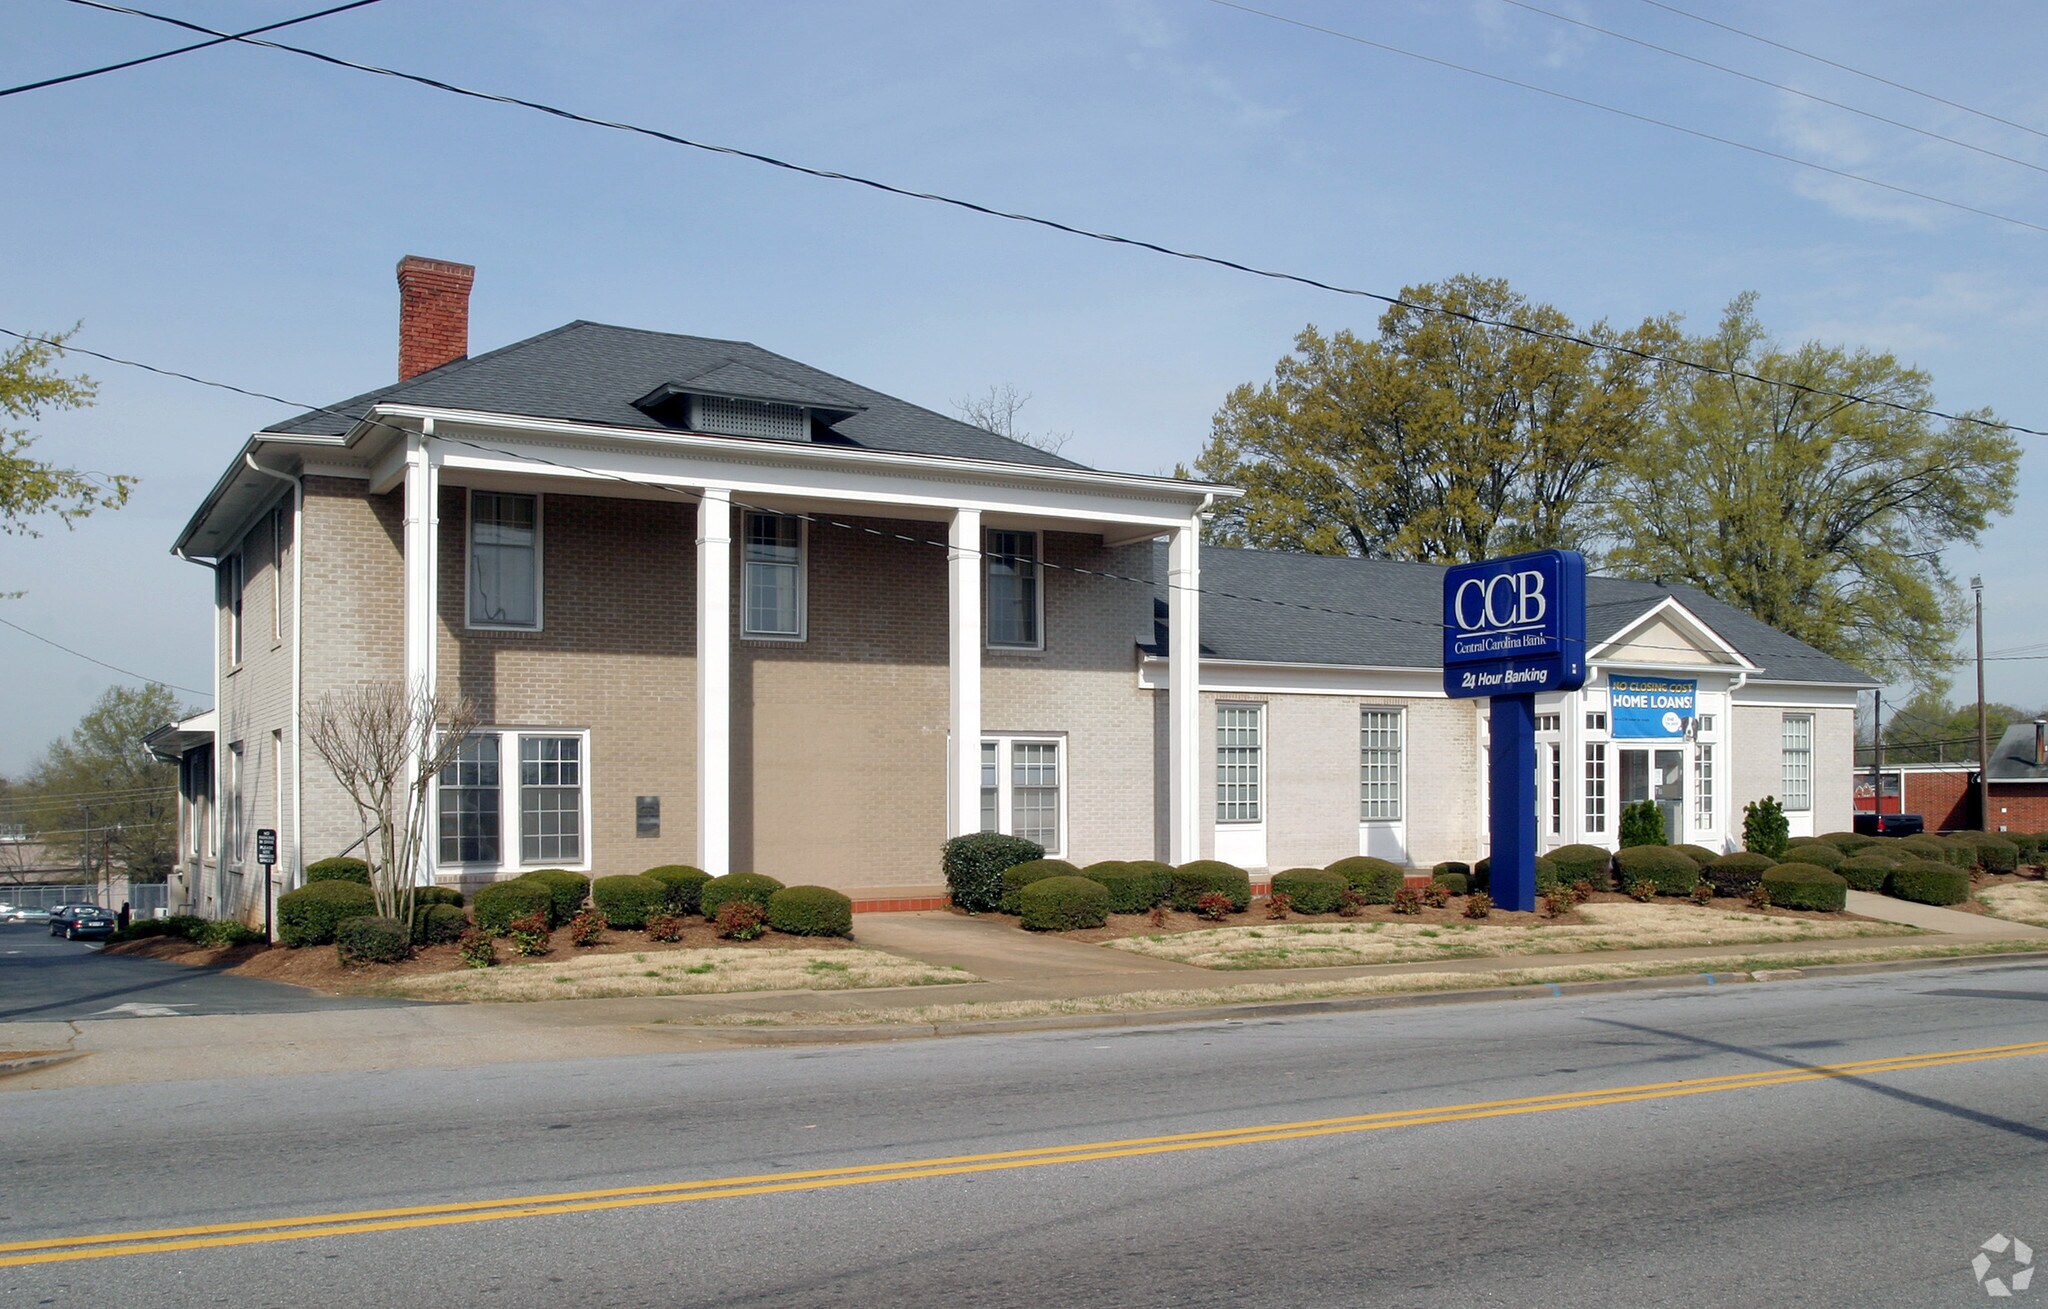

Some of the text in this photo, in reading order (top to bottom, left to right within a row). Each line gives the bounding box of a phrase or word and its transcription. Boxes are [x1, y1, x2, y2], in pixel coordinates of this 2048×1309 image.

[1455, 571, 1546, 630] CCB
[1455, 632, 1546, 654] Central Carolina Bank
[1462, 668, 1547, 688] 24 Hour Banking
[1613, 682, 1693, 693] NO CLOSING COST
[1613, 694, 1693, 709] HOME LOANS!
